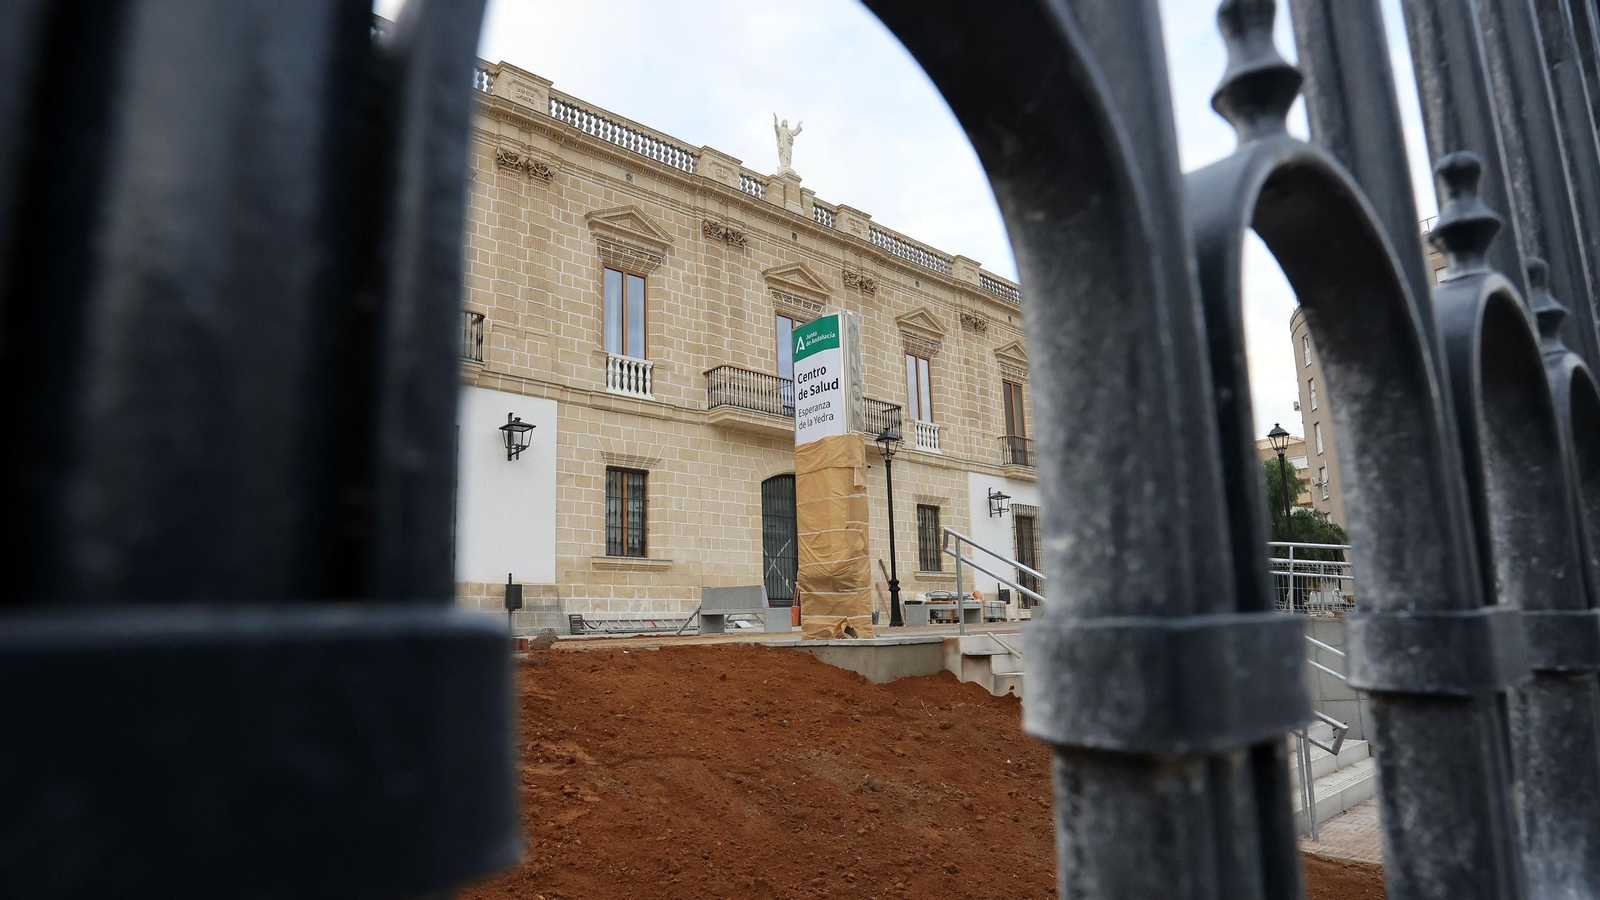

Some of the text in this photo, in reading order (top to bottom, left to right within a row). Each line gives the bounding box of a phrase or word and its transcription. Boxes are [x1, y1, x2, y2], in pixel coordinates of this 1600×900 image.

[806, 332, 818, 340] Junta
[811, 332, 835, 345] Andalucía
[798, 366, 826, 384] Centro
[799, 378, 838, 400] de Salud
[799, 401, 830, 417] Esperanza
[799, 412, 833, 430] de la Yedra
